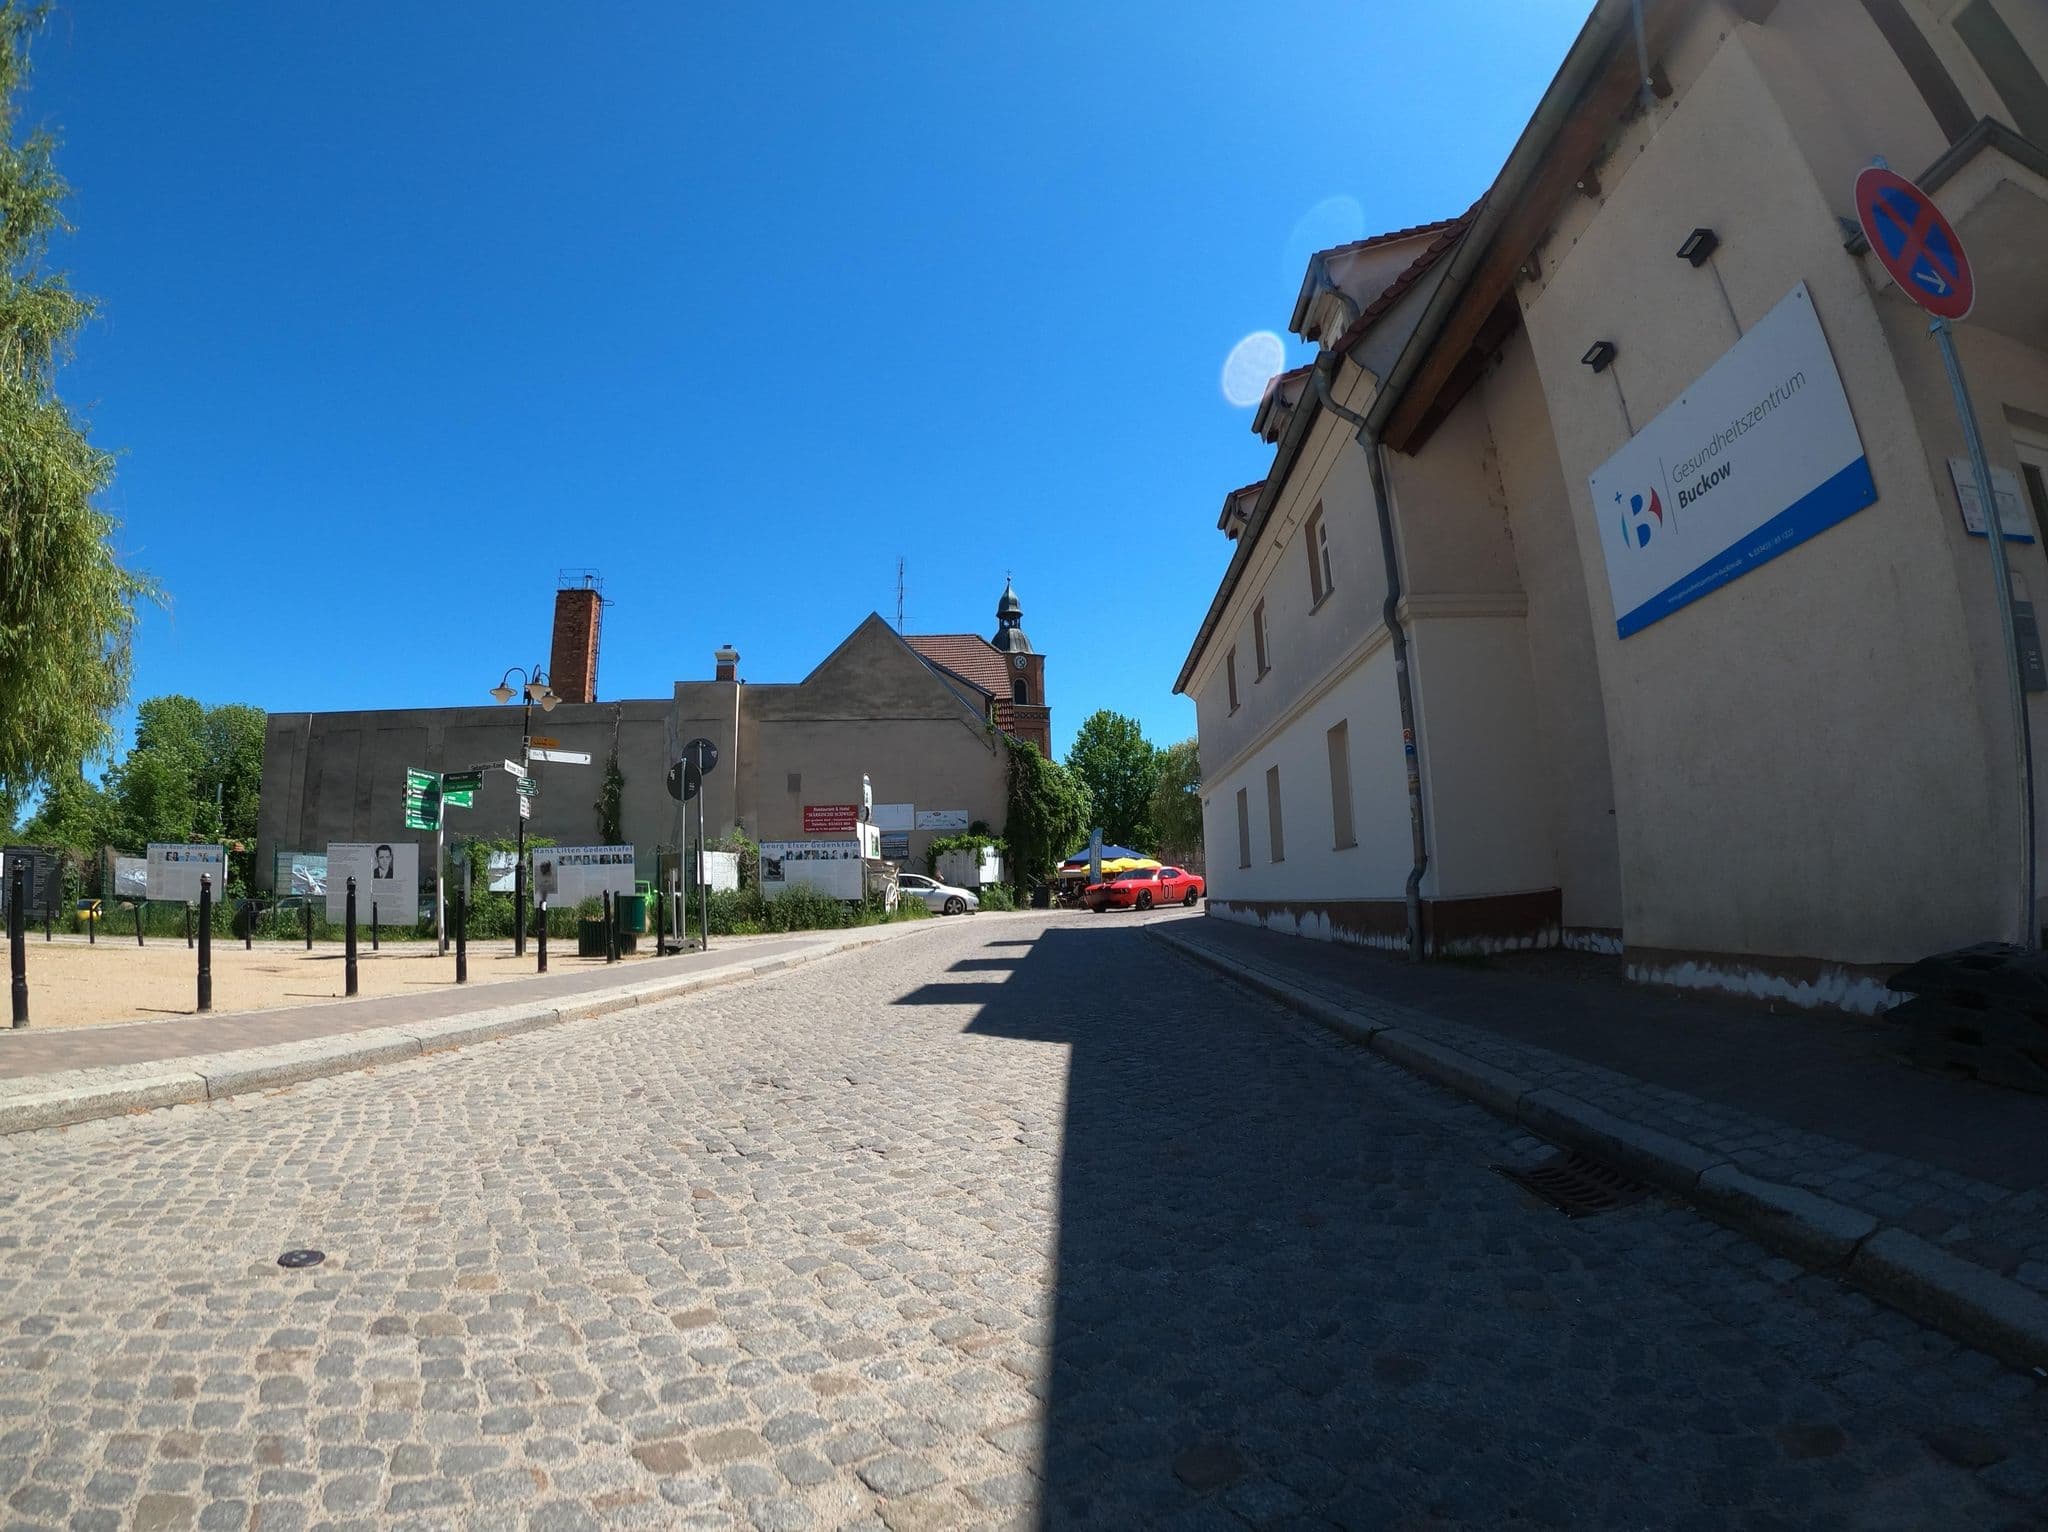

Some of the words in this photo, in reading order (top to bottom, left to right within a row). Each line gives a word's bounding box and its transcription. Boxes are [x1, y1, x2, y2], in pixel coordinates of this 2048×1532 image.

[1672, 371, 1806, 483] Gesundheitszentrum
[1678, 461, 1731, 509] Buckow
[556, 846, 581, 854] Litten
[583, 845, 633, 853] Gedenktafel
[760, 842, 784, 850] Georg
[787, 841, 808, 849] Elser
[1163, 883, 1174, 899] 01
